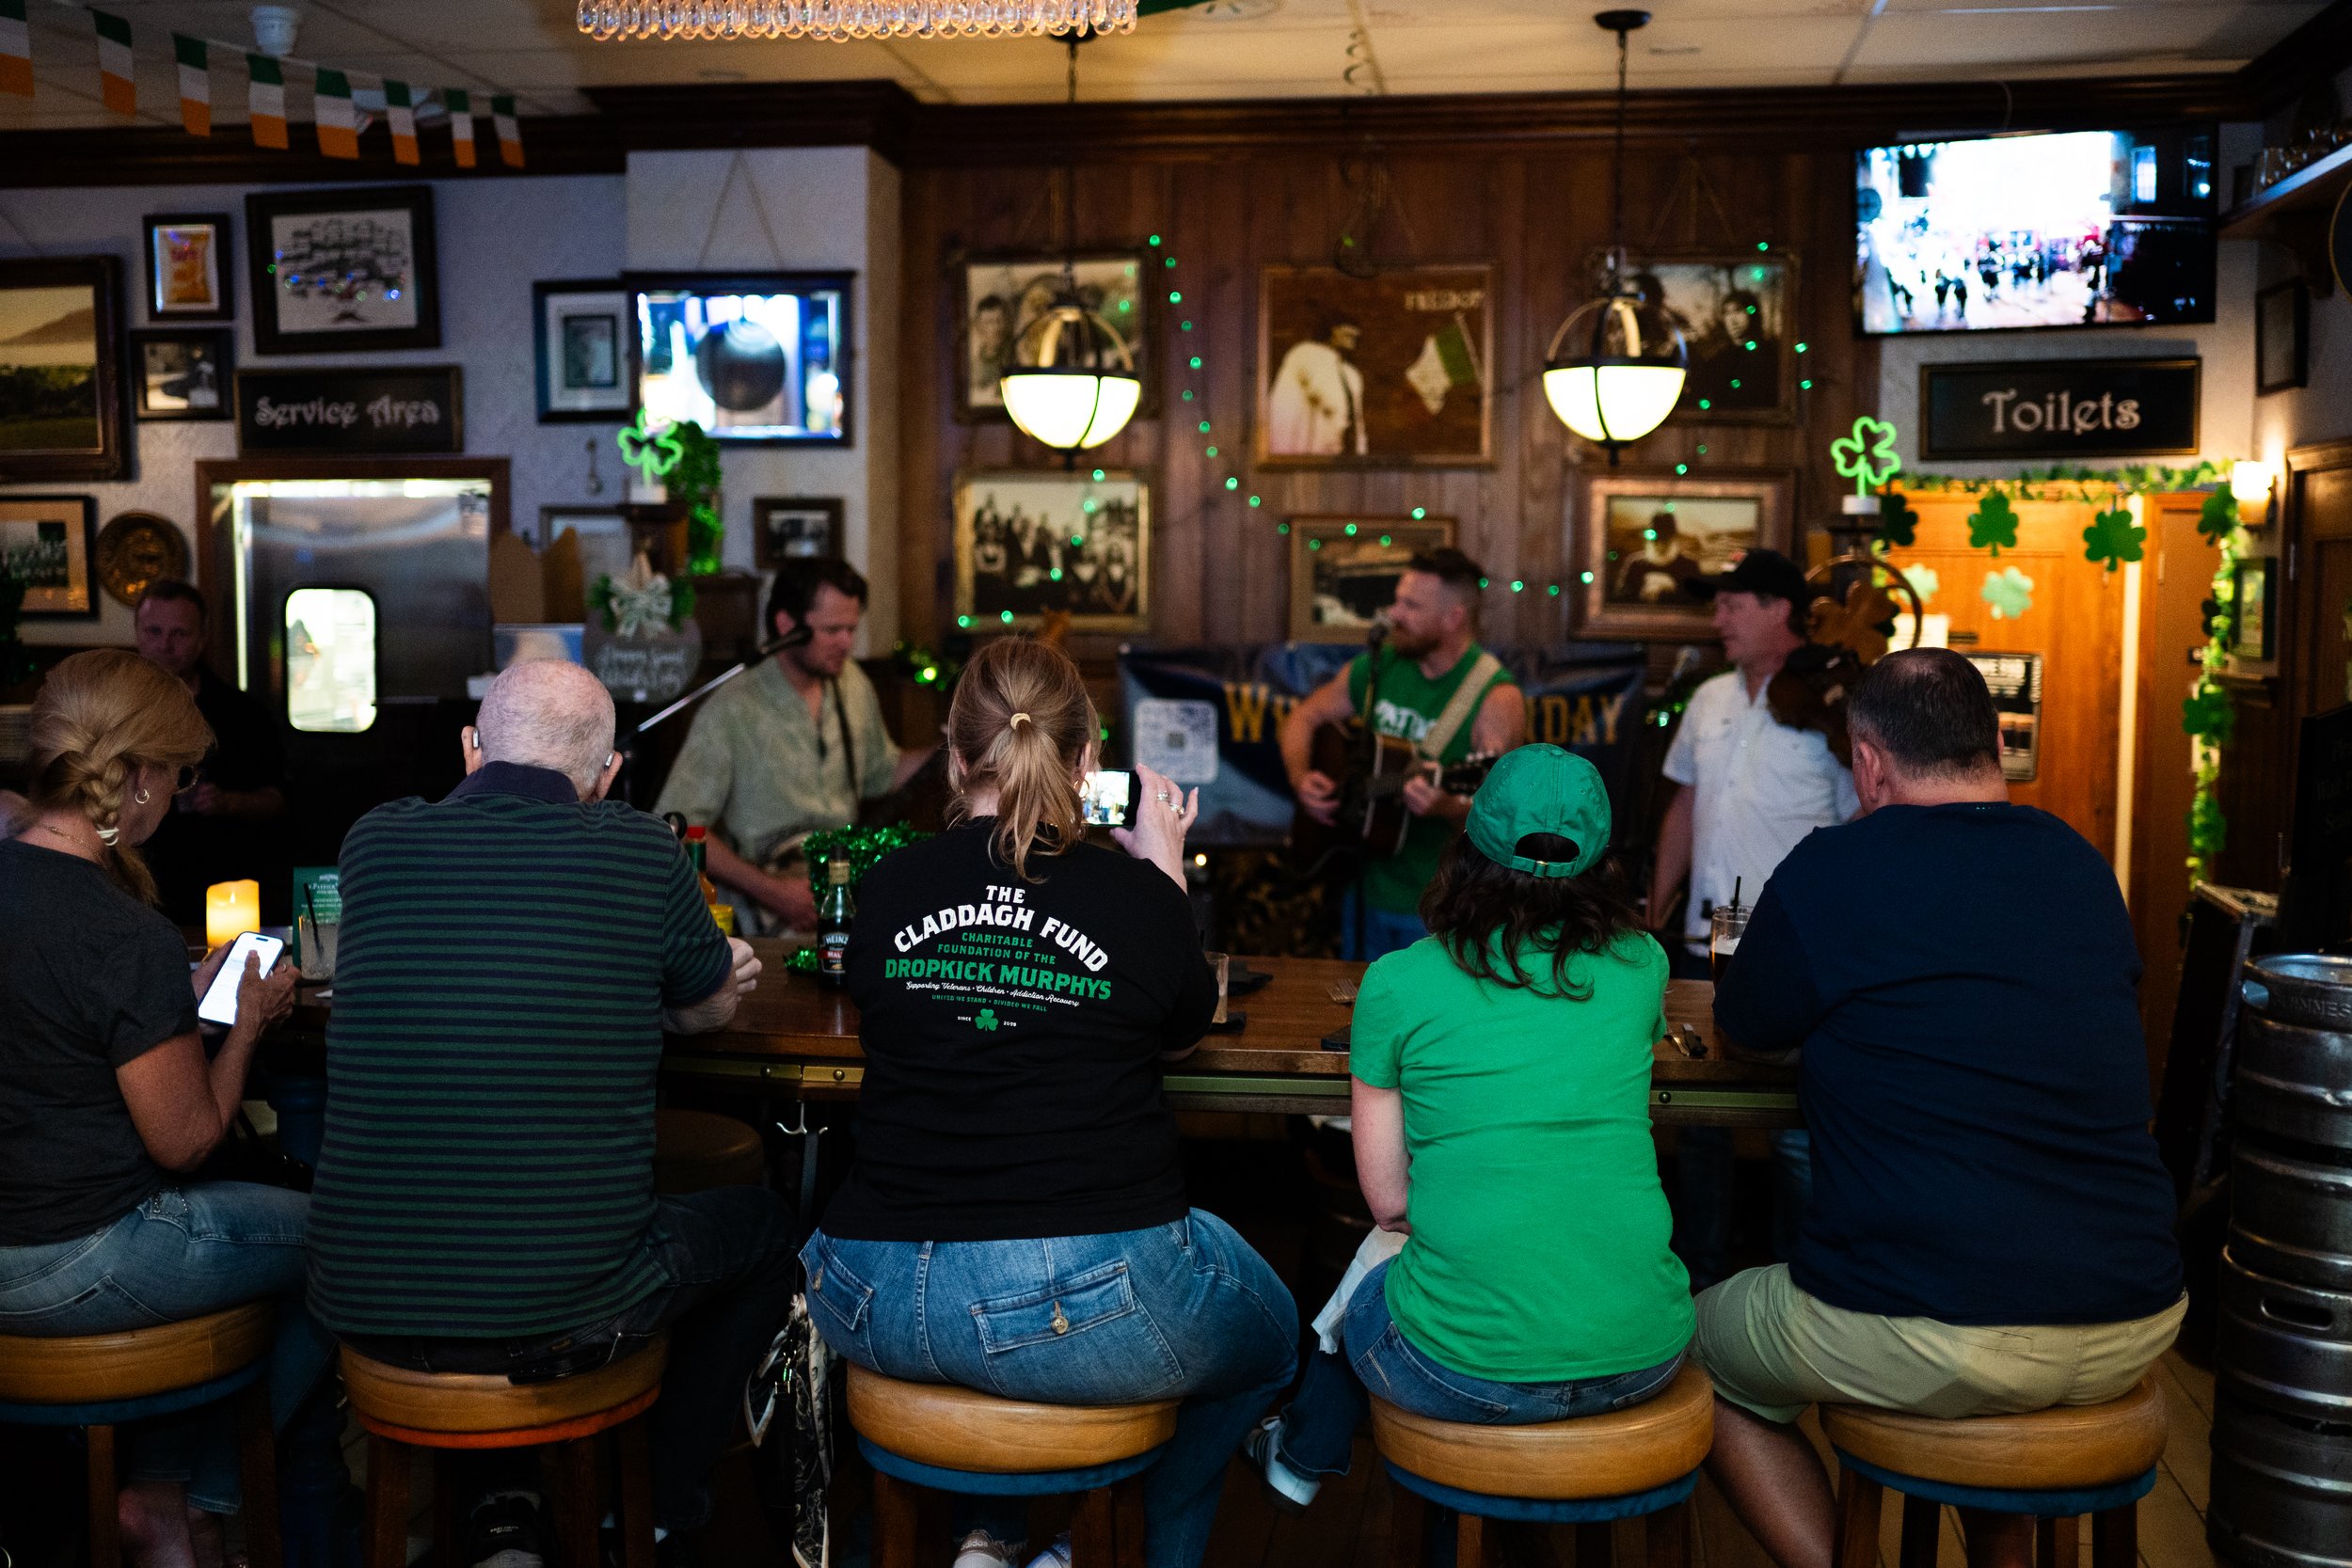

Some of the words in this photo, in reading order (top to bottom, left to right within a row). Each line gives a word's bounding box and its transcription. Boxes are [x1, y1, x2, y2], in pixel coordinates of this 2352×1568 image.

[254, 395, 359, 430] Service
[365, 393, 440, 429] Area
[1980, 387, 2142, 436] Toilets
[985, 885, 1025, 904] THE
[894, 903, 1035, 953] CLADDAGH
[1039, 916, 1108, 973] FUND
[961, 932, 1034, 948] CHARITABLE
[937, 943, 1011, 958] FOUNDATION
[1014, 951, 1030, 961] OF
[1033, 953, 1057, 965] THE
[884, 958, 995, 982] DROPKICK
[998, 964, 1112, 1000] MURPHYS
[906, 981, 941, 991] Supporting
[941, 982, 972, 991] Veterans
[976, 985, 1006, 995] Children
[1009, 989, 1044, 1001] Addiction
[1044, 993, 1080, 1007] Recovery
[993, 999, 1020, 1008] DIVIDED
[1032, 1004, 1047, 1012] FALL
